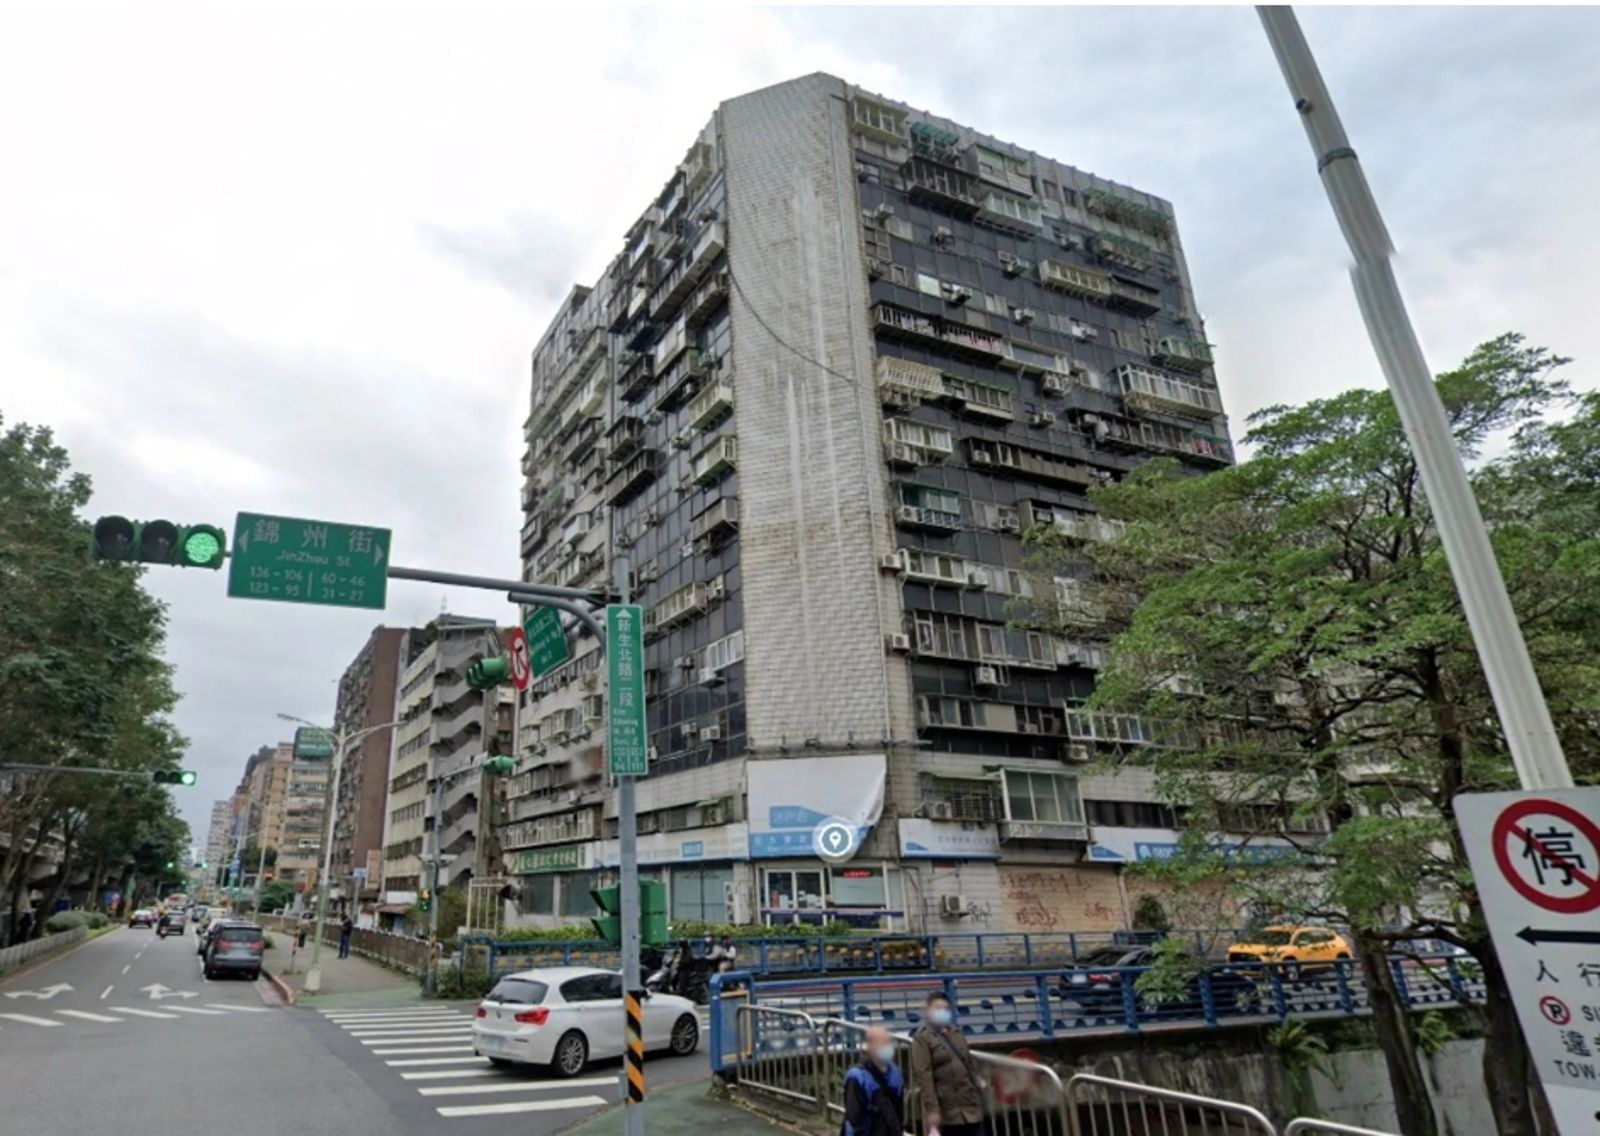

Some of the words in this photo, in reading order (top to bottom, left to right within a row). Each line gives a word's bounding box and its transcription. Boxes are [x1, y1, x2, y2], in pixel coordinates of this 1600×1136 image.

[253, 520, 373, 553] 錦州街
[1523, 827, 1586, 887] 停
